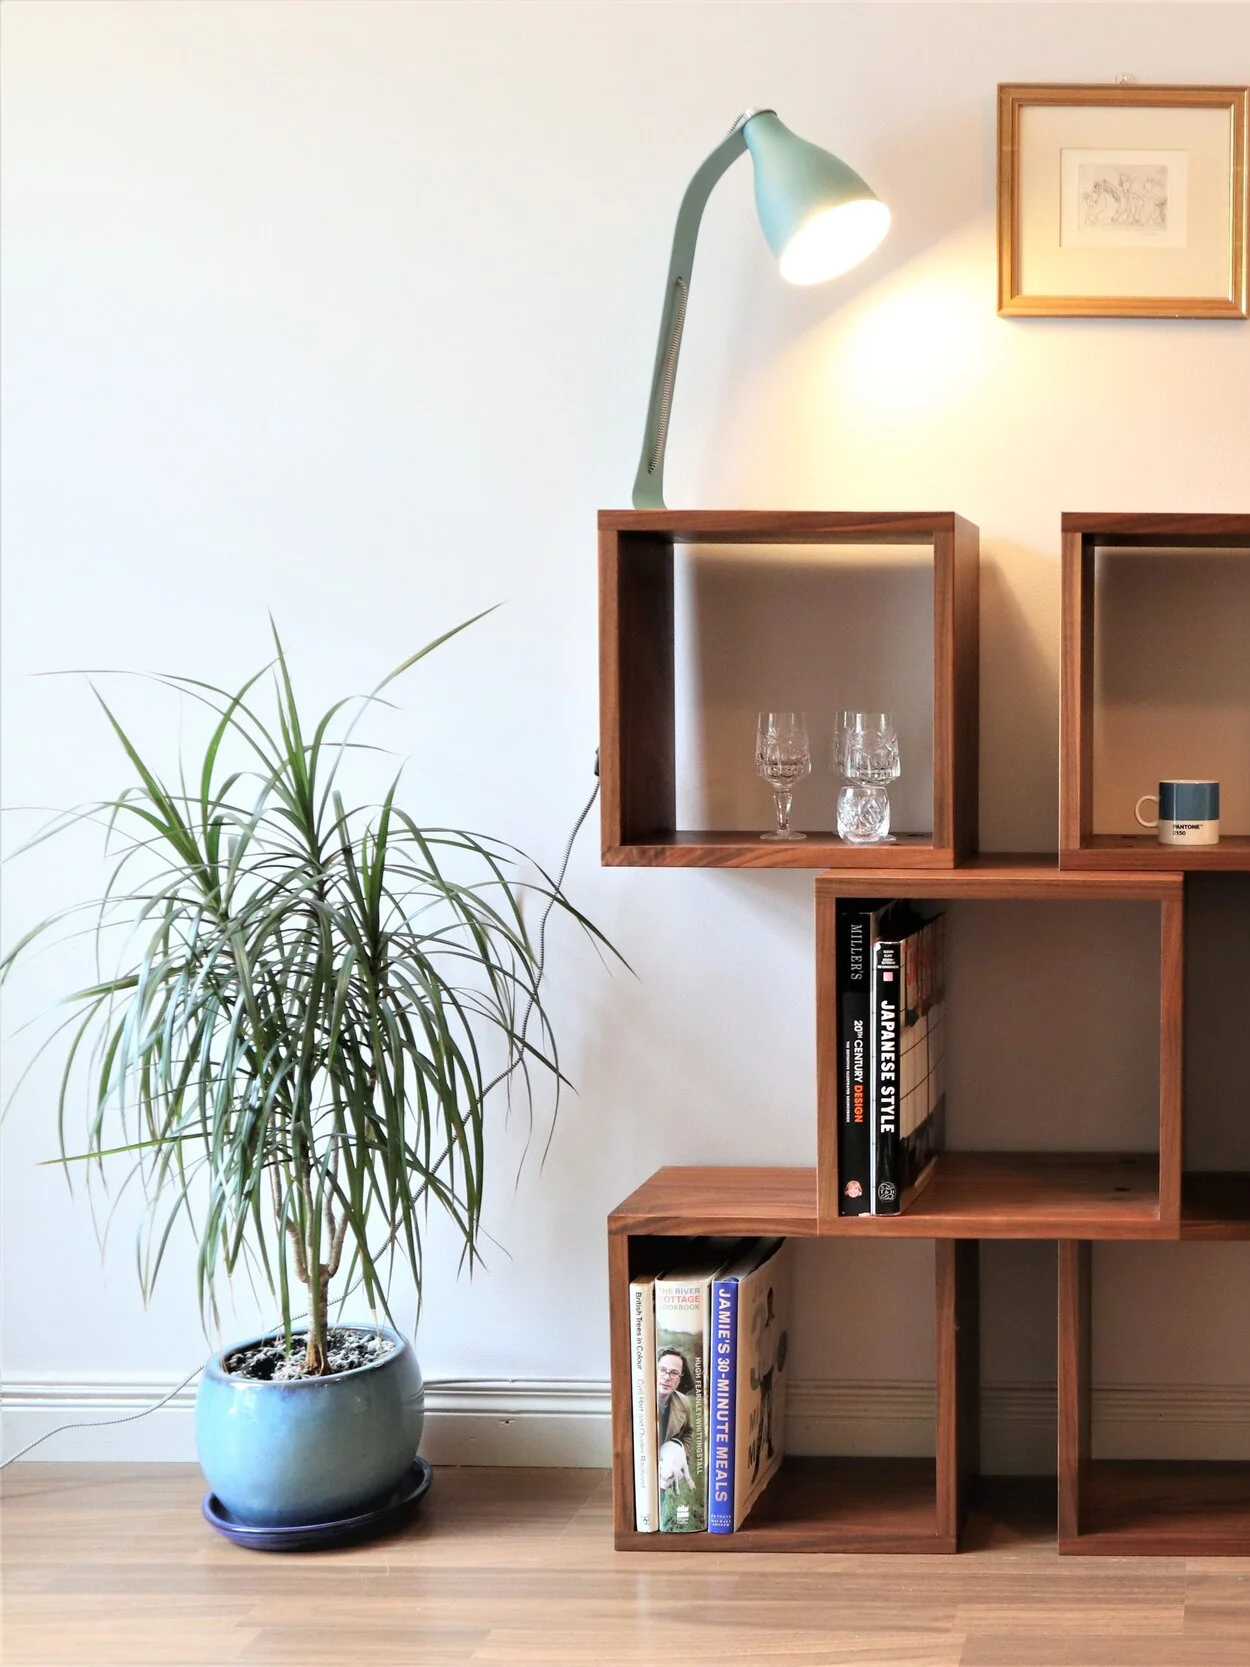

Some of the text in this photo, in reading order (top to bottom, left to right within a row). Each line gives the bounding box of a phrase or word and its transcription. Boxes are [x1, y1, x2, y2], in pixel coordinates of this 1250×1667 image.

[850, 924, 863, 980] MILLER'S
[854, 1039, 863, 1083] CENTURY
[880, 1000, 896, 1133] JAPANESE STYLE
[854, 1085, 864, 1123] DESIGN
[635, 1291, 643, 1316] British
[660, 1295, 701, 1303] OTTAGE
[674, 1287, 700, 1295] RIVER
[636, 1345, 644, 1370] Colour
[694, 1357, 704, 1475] HUGH FEARNLEY-WHITTINGSTALL
[715, 1289, 731, 1502] JAMIE'S 30-MINUTE MEALS
